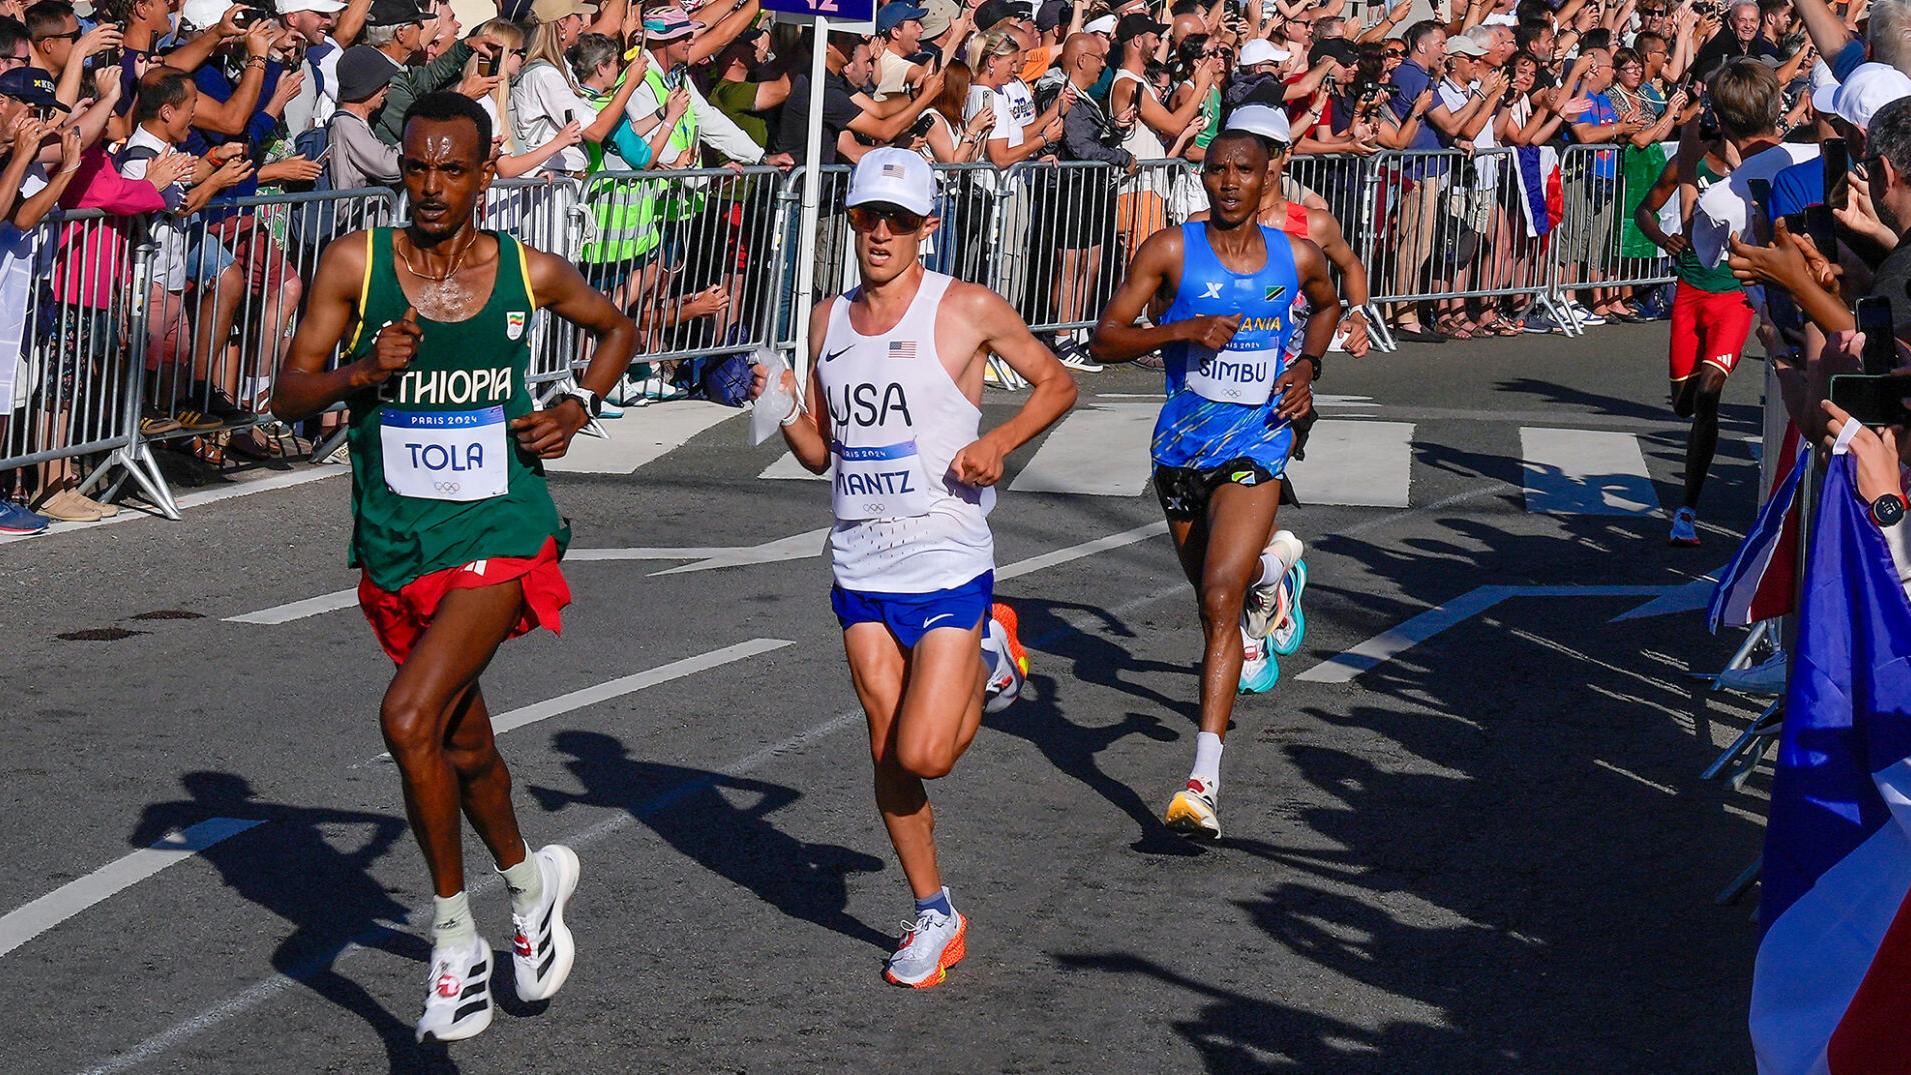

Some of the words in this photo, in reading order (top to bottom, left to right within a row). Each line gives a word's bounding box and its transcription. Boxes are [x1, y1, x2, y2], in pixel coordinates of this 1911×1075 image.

[1198, 357, 1267, 382] SIMBU
[827, 382, 912, 427] USA
[411, 417, 444, 425] PARIS
[447, 416, 478, 425] 2024
[405, 442, 483, 471] TOLA
[861, 450, 887, 458] 2024
[835, 470, 914, 495] MANTZ
